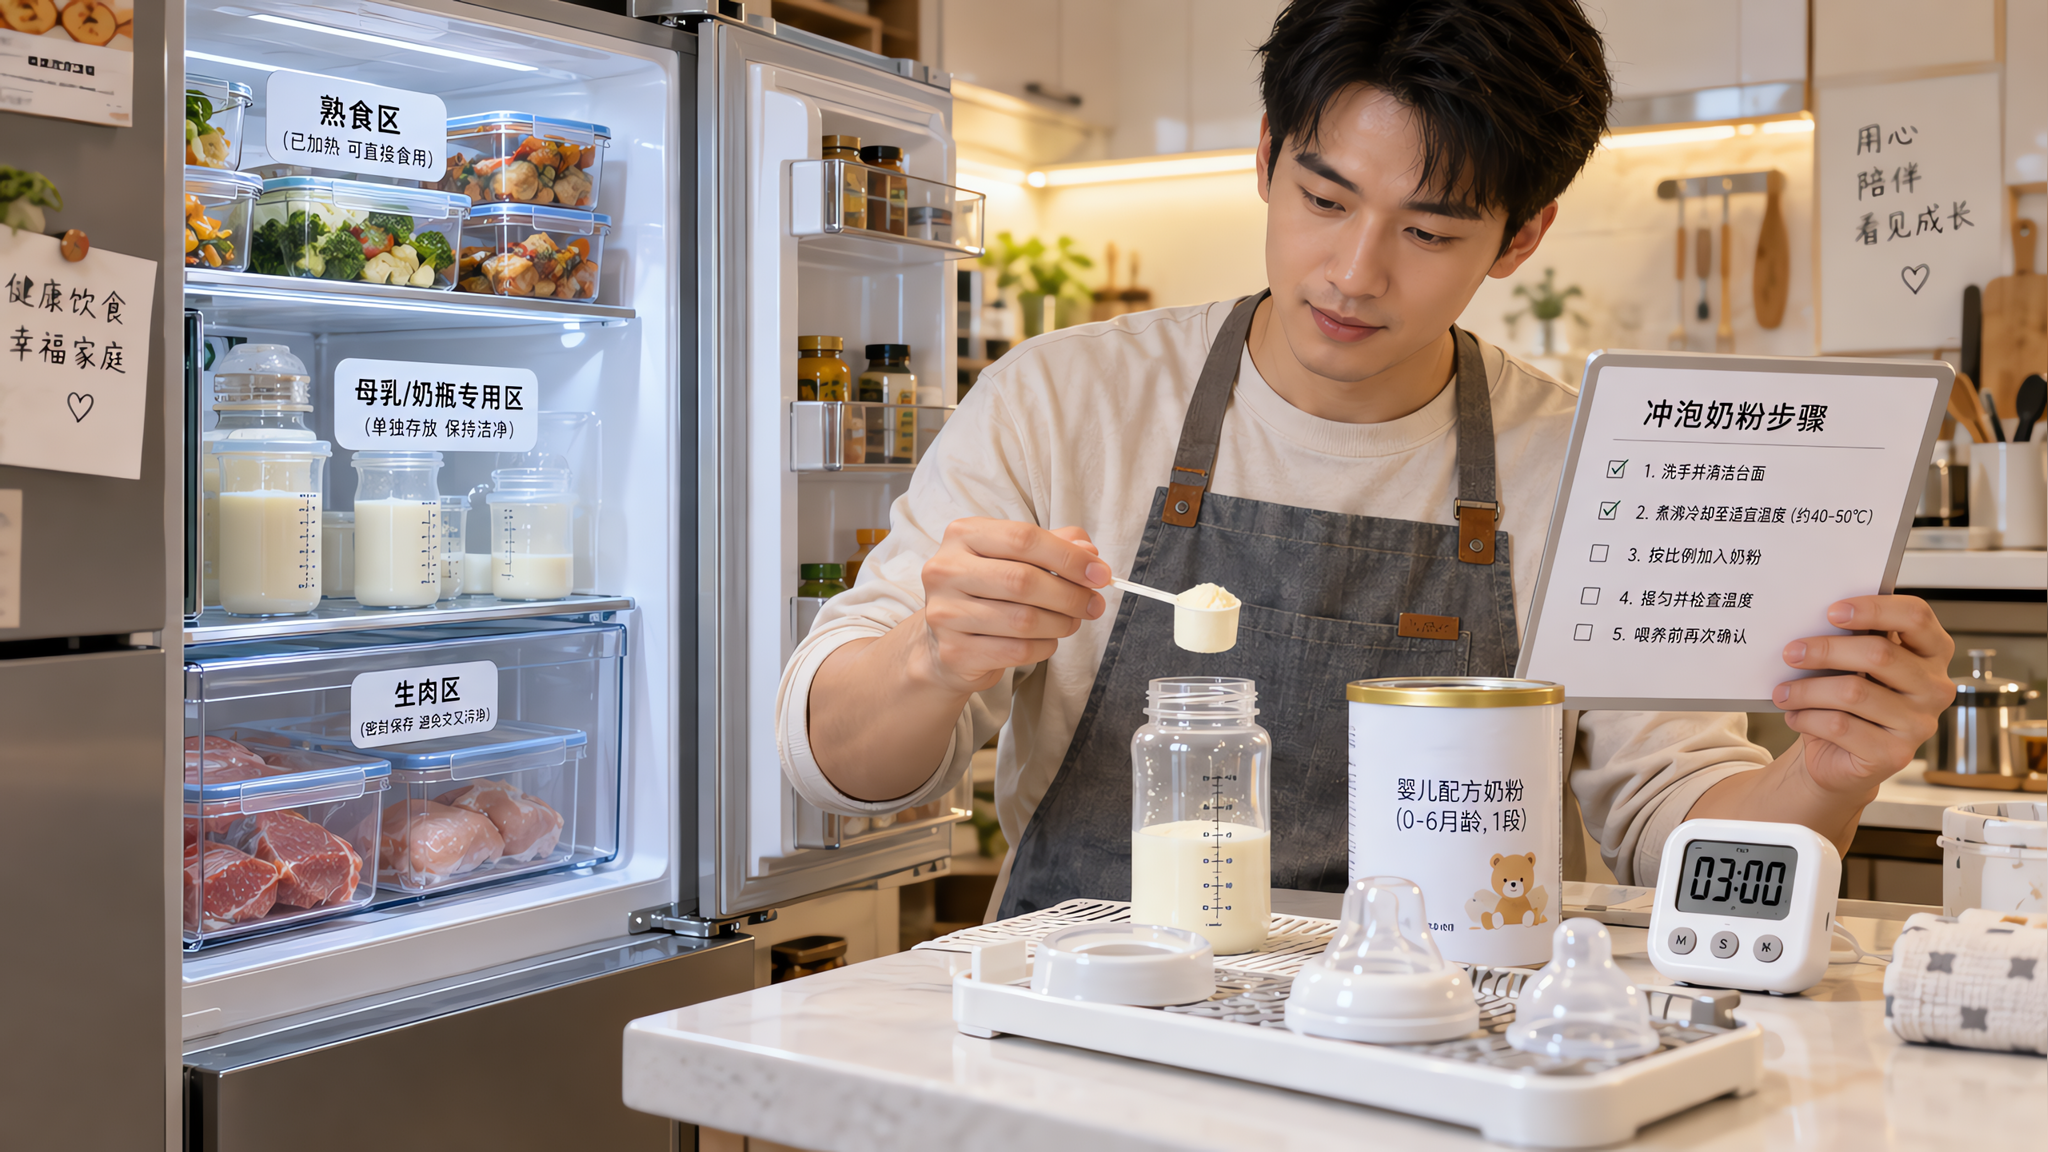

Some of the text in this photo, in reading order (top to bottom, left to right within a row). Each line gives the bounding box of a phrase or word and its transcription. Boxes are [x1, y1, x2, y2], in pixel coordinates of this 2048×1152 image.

[320, 95, 401, 135] 熟食区
[1857, 124, 1918, 156] 用心
[1857, 162, 1922, 201] 陪伴
[1855, 200, 1975, 245] 看见成长
[4, 273, 126, 325] 健康饮食
[9, 325, 126, 374] 幸福家庭
[355, 378, 524, 411] 母乳/奶瓶专用区
[364, 417, 514, 440] (单独存放 保持洁净)
[1643, 399, 1828, 433] 冲泡奶粉步骤
[394, 676, 461, 708] 生肉区
[1397, 777, 1525, 803] 婴儿配方奶粉
[1690, 856, 1787, 907] 03:00
[1675, 934, 1687, 946] M
[1718, 938, 1729, 950] S
